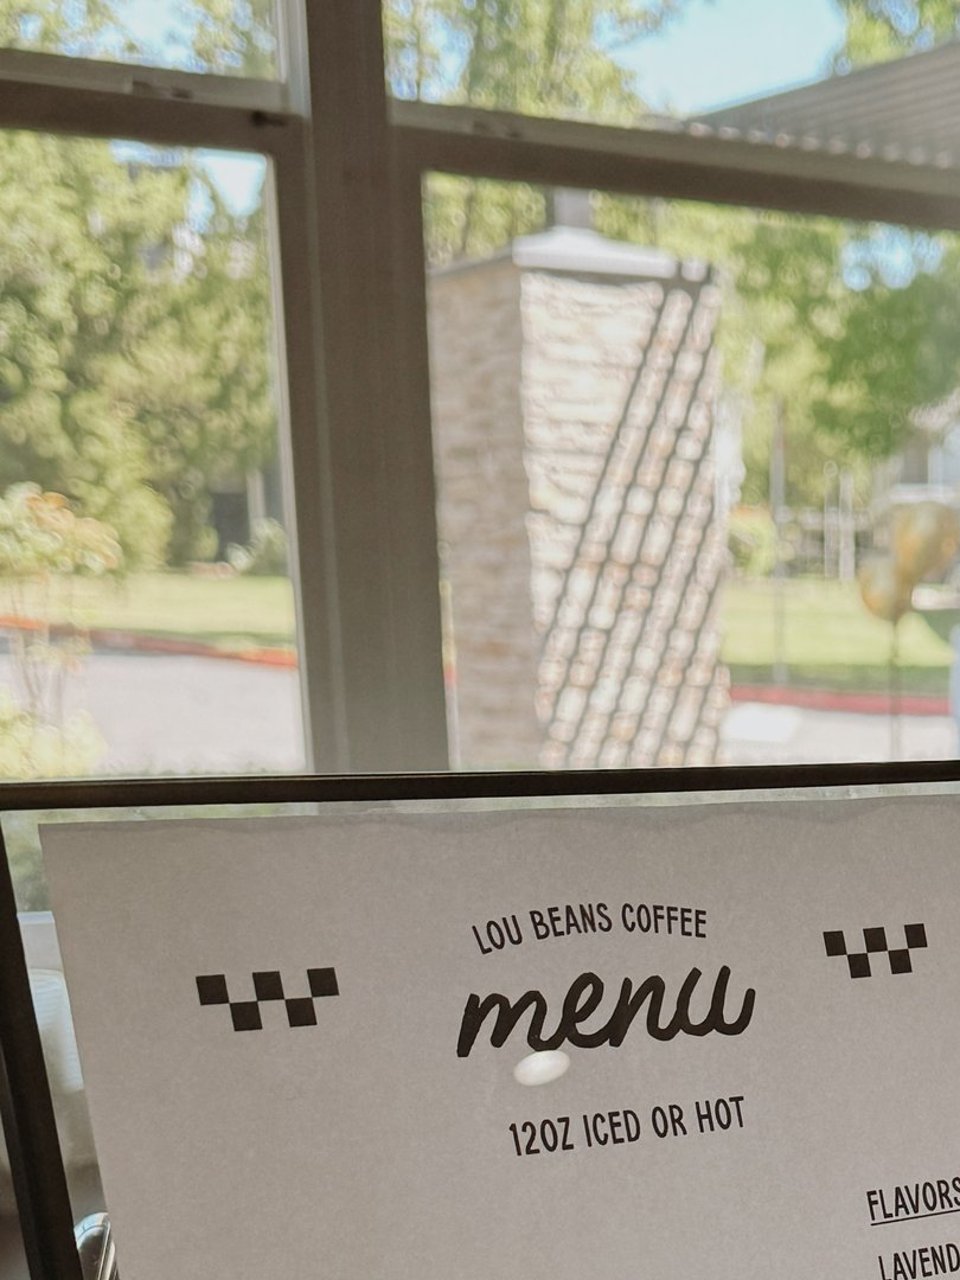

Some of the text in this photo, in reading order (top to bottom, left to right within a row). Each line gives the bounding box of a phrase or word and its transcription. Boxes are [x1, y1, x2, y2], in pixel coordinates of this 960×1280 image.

[472, 903, 706, 955] LOU BEANS COFFEE
[457, 965, 757, 1058] menu
[509, 1096, 744, 1156] 12OZ ICED OR HOT
